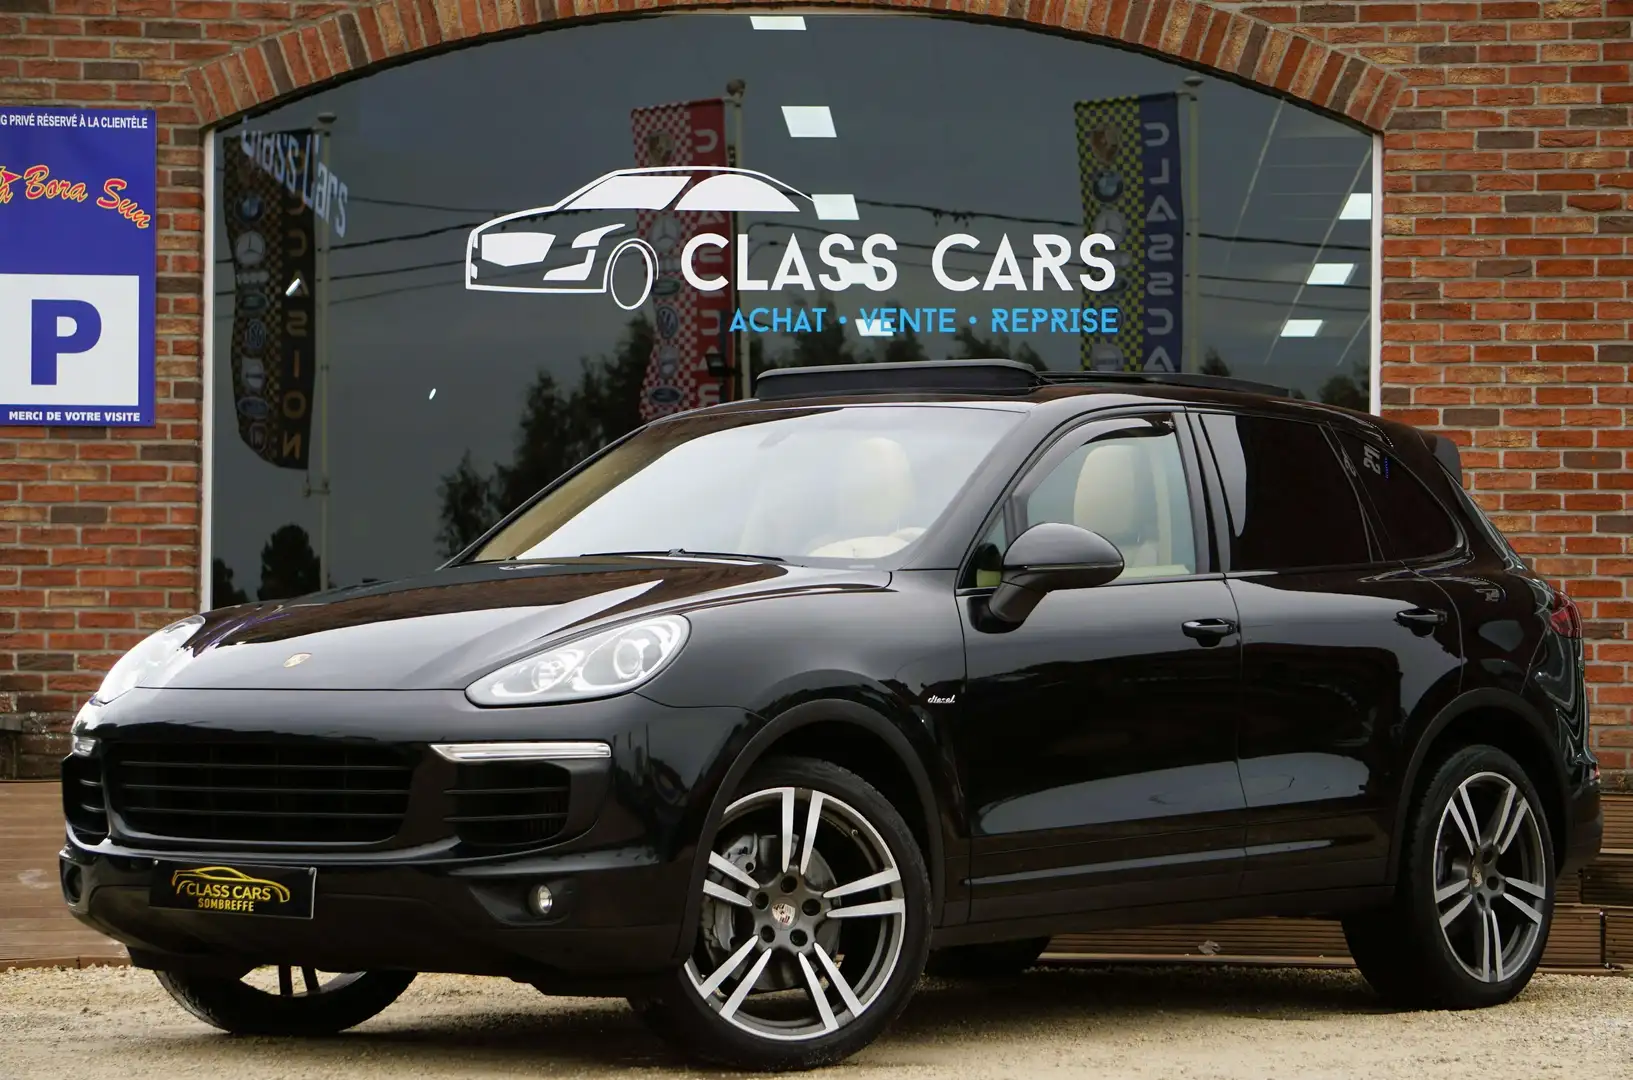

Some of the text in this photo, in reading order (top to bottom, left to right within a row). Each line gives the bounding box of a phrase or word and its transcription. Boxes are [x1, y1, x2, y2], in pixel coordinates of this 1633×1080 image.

[9, 113, 35, 126] PRIVÉ
[37, 113, 78, 127] RÉSERVÉ
[79, 114, 87, 128] À
[88, 116, 100, 128] LA
[101, 115, 148, 129] CLIENTÈLE
[23, 164, 88, 203] Bora
[96, 178, 151, 229] Sun
[681, 232, 1116, 292] CLASS CARS
[728, 307, 1119, 333] ACHAT VENTE REPRISE
[31, 298, 102, 386] P
[8, 411, 140, 422] MERCI DE VOTRE VISITE
[186, 882, 271, 901] CLASS CARS
[197, 897, 254, 912] SOMBREFFE
